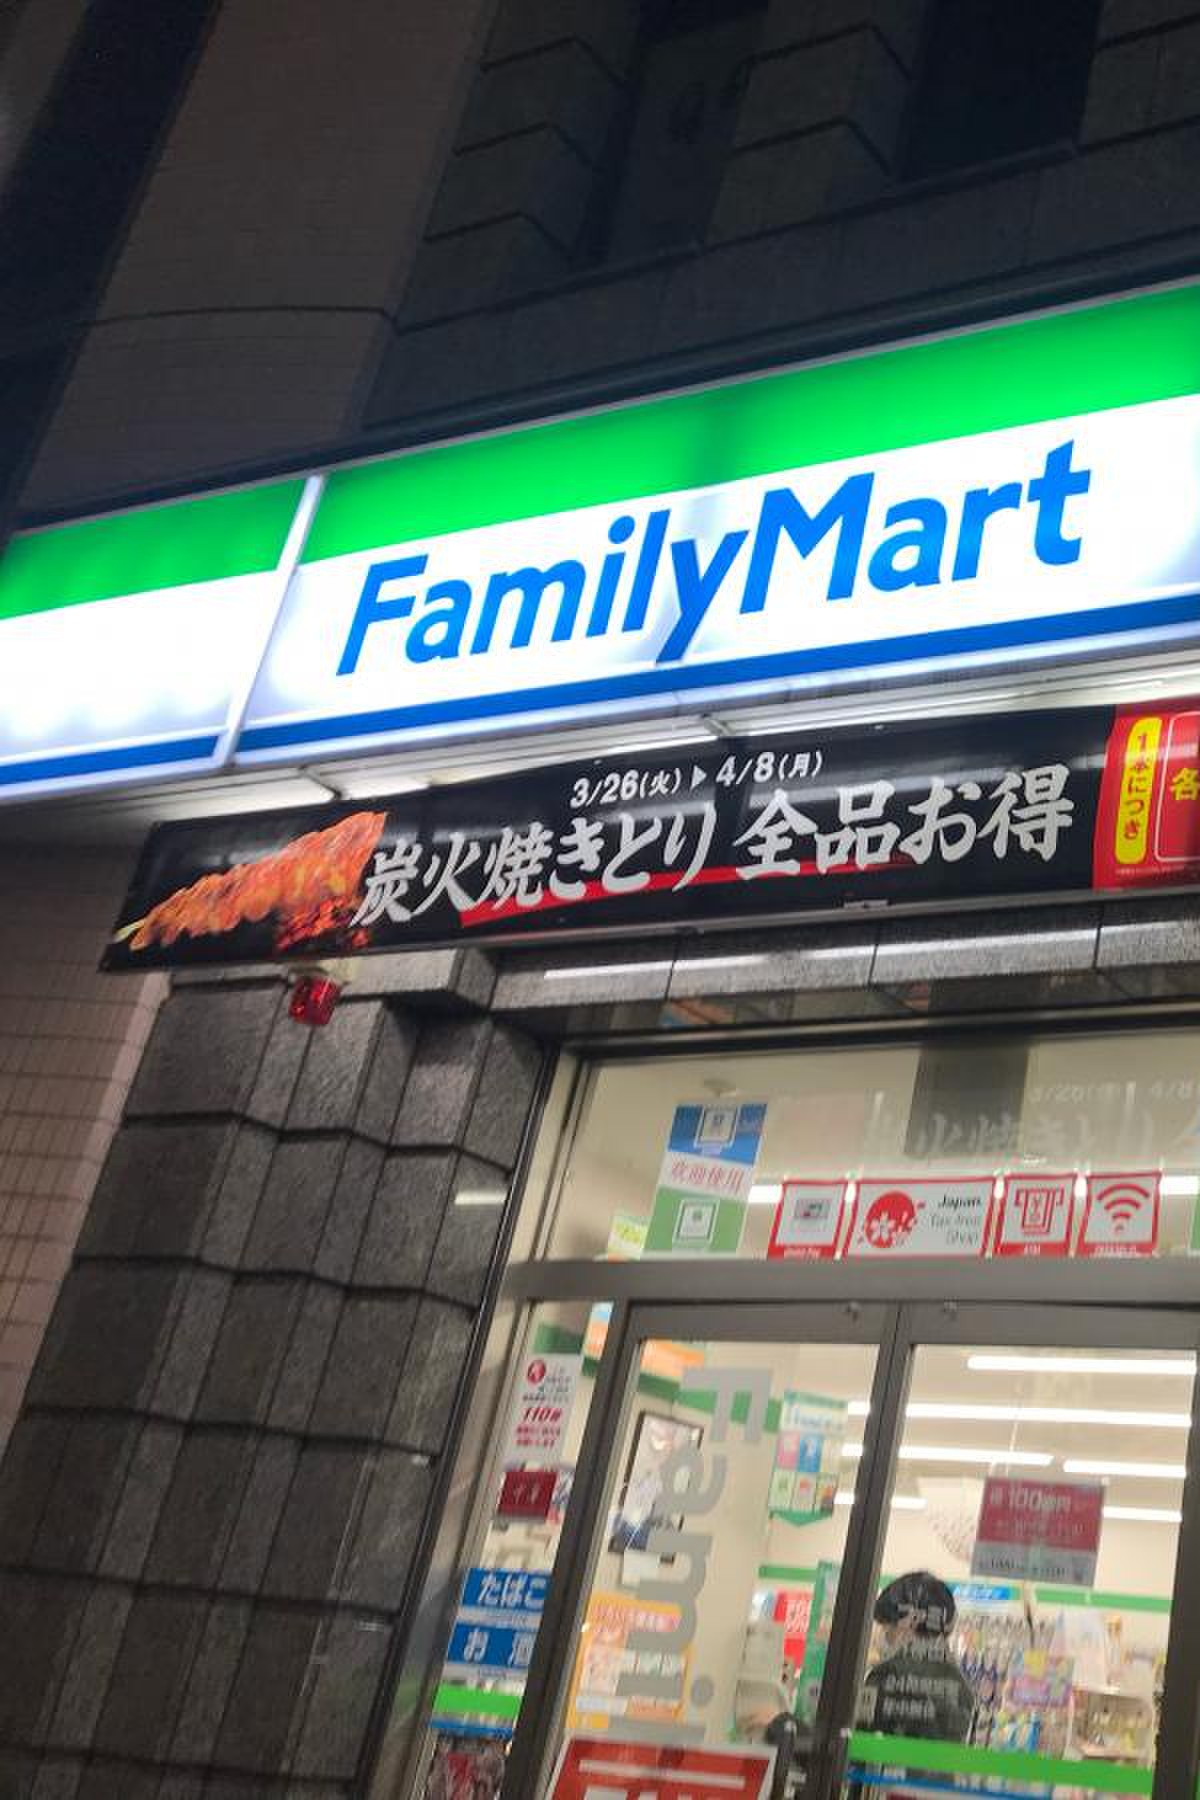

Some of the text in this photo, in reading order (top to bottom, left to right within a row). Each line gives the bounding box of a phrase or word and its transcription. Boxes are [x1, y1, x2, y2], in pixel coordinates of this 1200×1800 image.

[335, 439, 1092, 674] FamilyMart
[350, 799, 717, 928] 炭火焼きとり
[731, 763, 1075, 880] 全品お得
